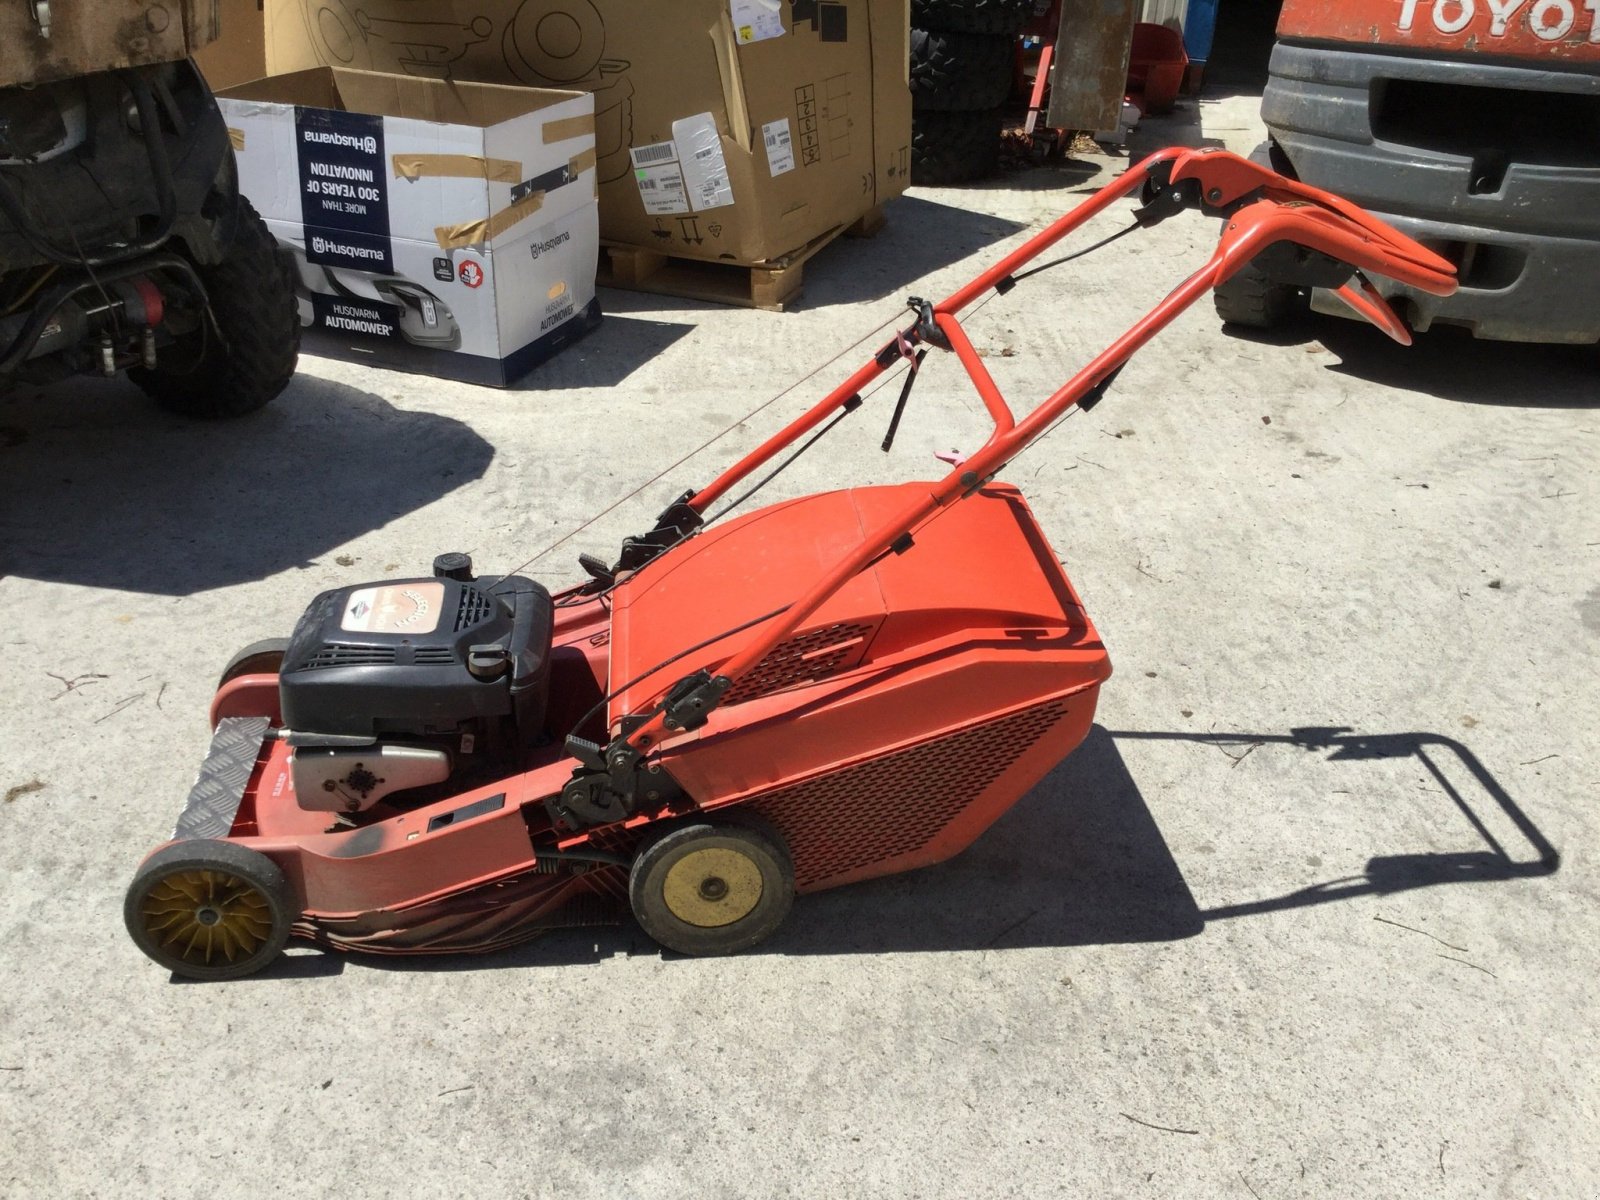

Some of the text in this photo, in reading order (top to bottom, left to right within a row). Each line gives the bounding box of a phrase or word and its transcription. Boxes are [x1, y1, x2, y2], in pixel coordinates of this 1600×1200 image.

[304, 131, 364, 151] Husqvarna
[310, 162, 374, 182] INNOVATION
[306, 180, 380, 201] 300 YEARS OF
[322, 200, 367, 215] MORE THAN
[325, 240, 385, 260] Husqvarna
[538, 231, 570, 254] Husqvarna
[333, 304, 381, 320] HUSQVARNA
